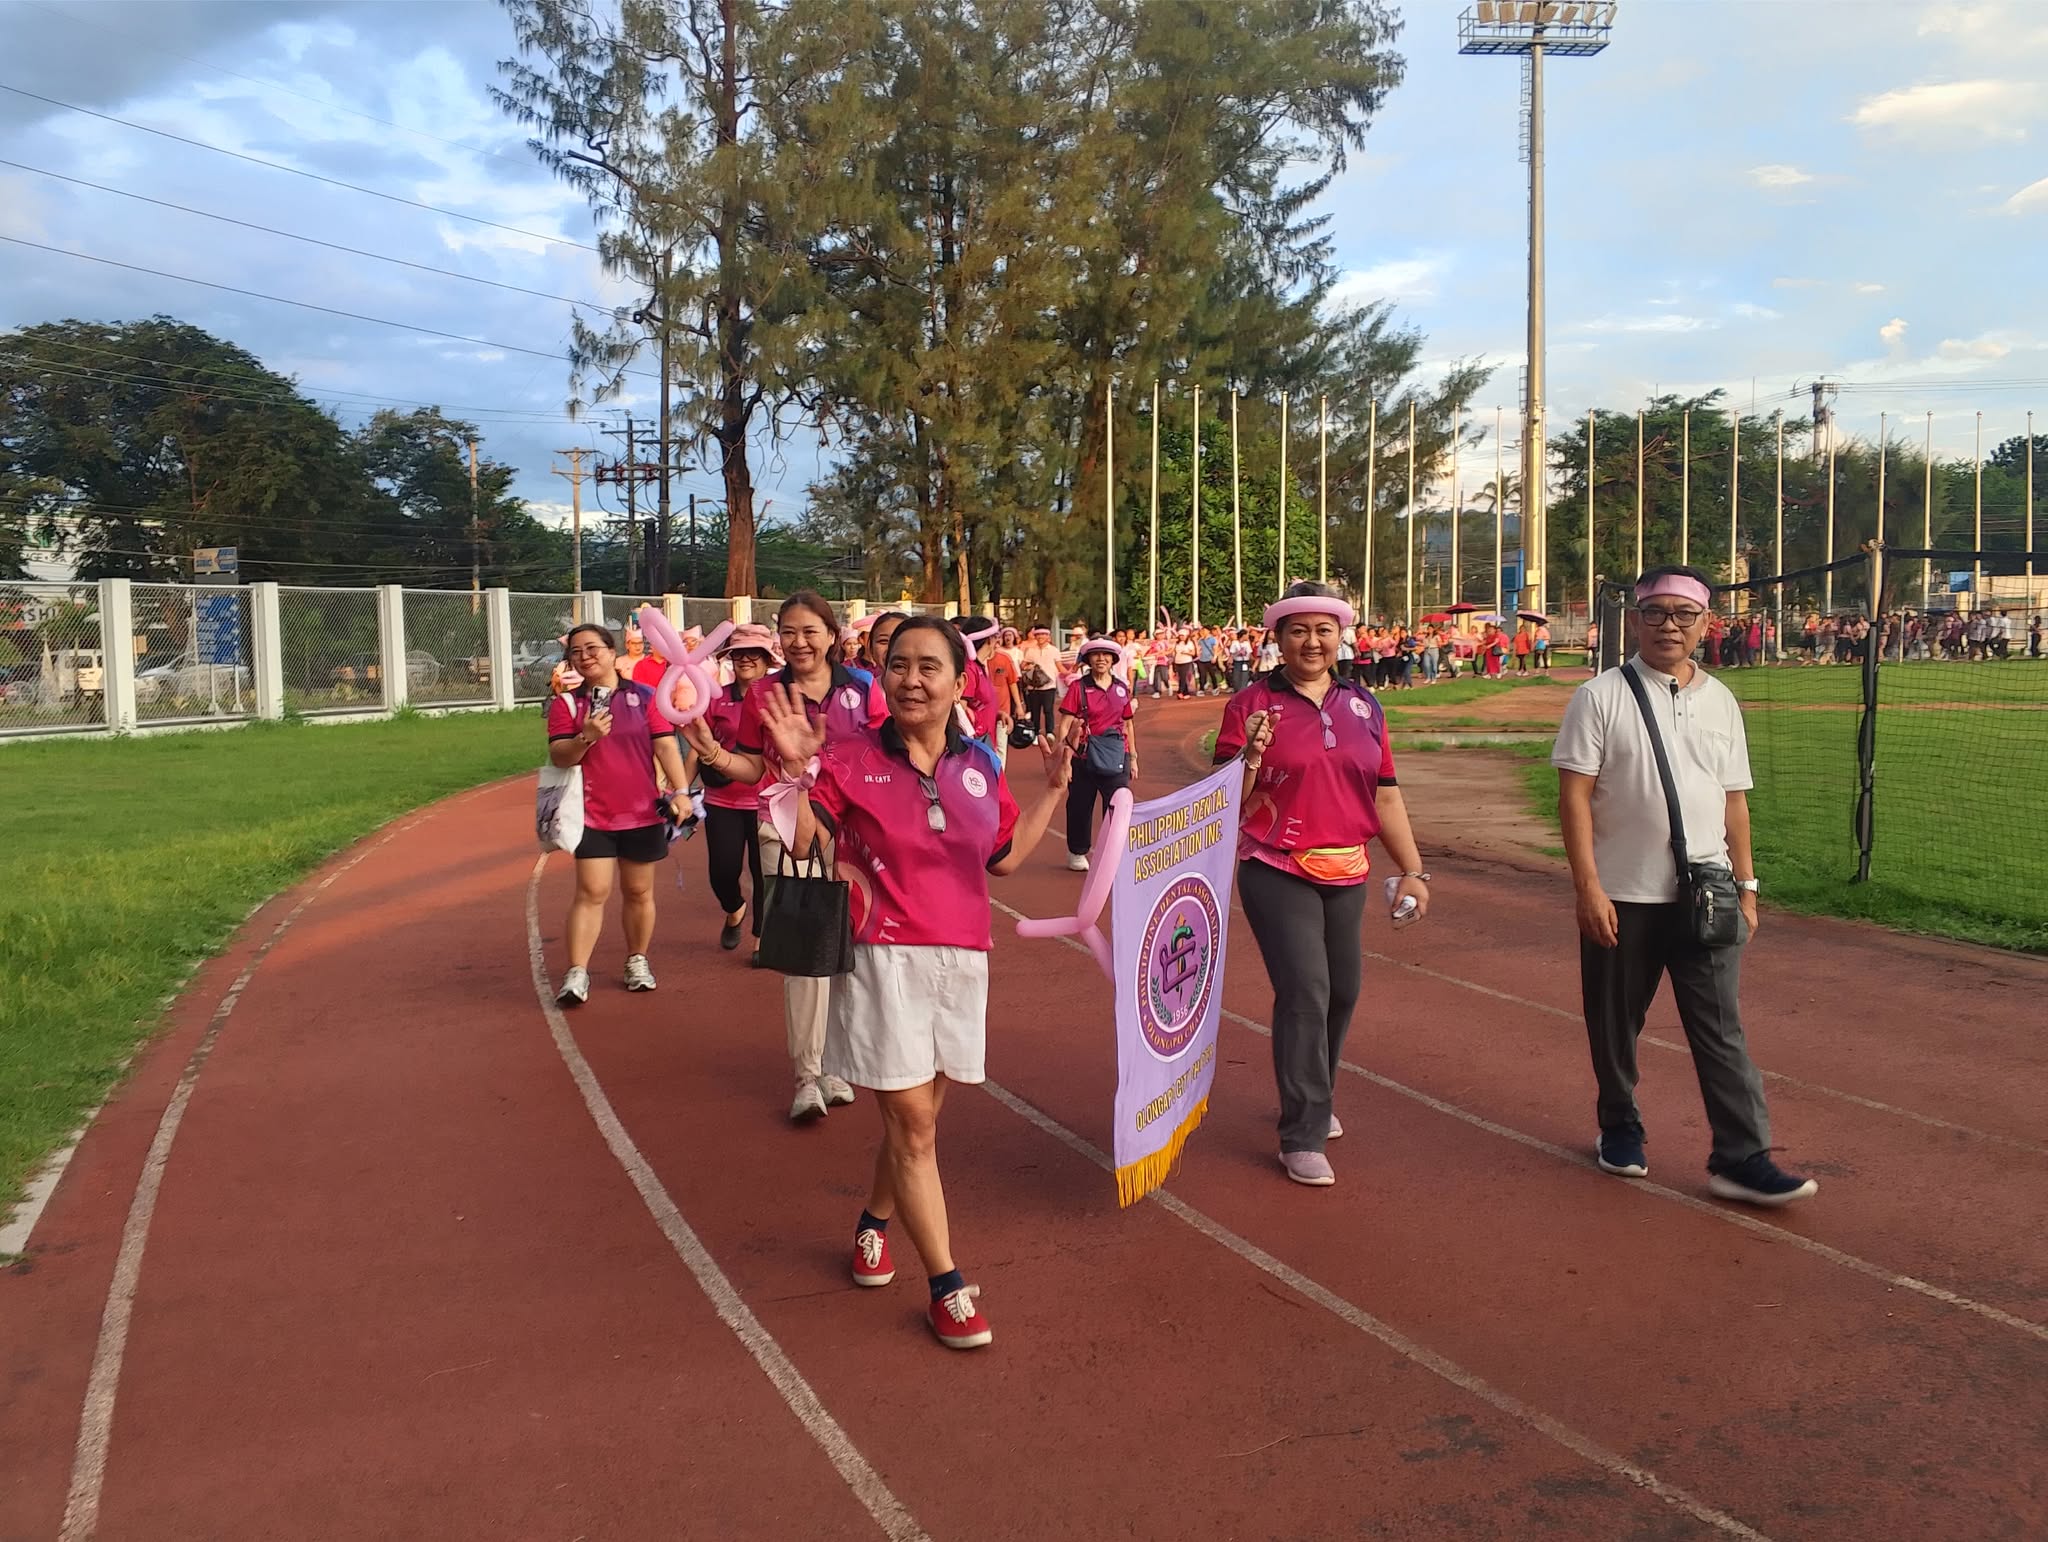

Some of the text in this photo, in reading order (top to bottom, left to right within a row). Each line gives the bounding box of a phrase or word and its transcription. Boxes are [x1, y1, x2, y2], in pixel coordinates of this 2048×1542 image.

[1129, 785, 1229, 852] PHILIPPINE DENTAL
[1134, 828, 1203, 885] ASSOCIATION
[1160, 883, 1192, 913] DENTAL
[1193, 884, 1219, 960] ASSOCIATION
[1147, 1021, 1184, 1050] OLONGAPO
[1172, 1004, 1190, 1023] 1956
